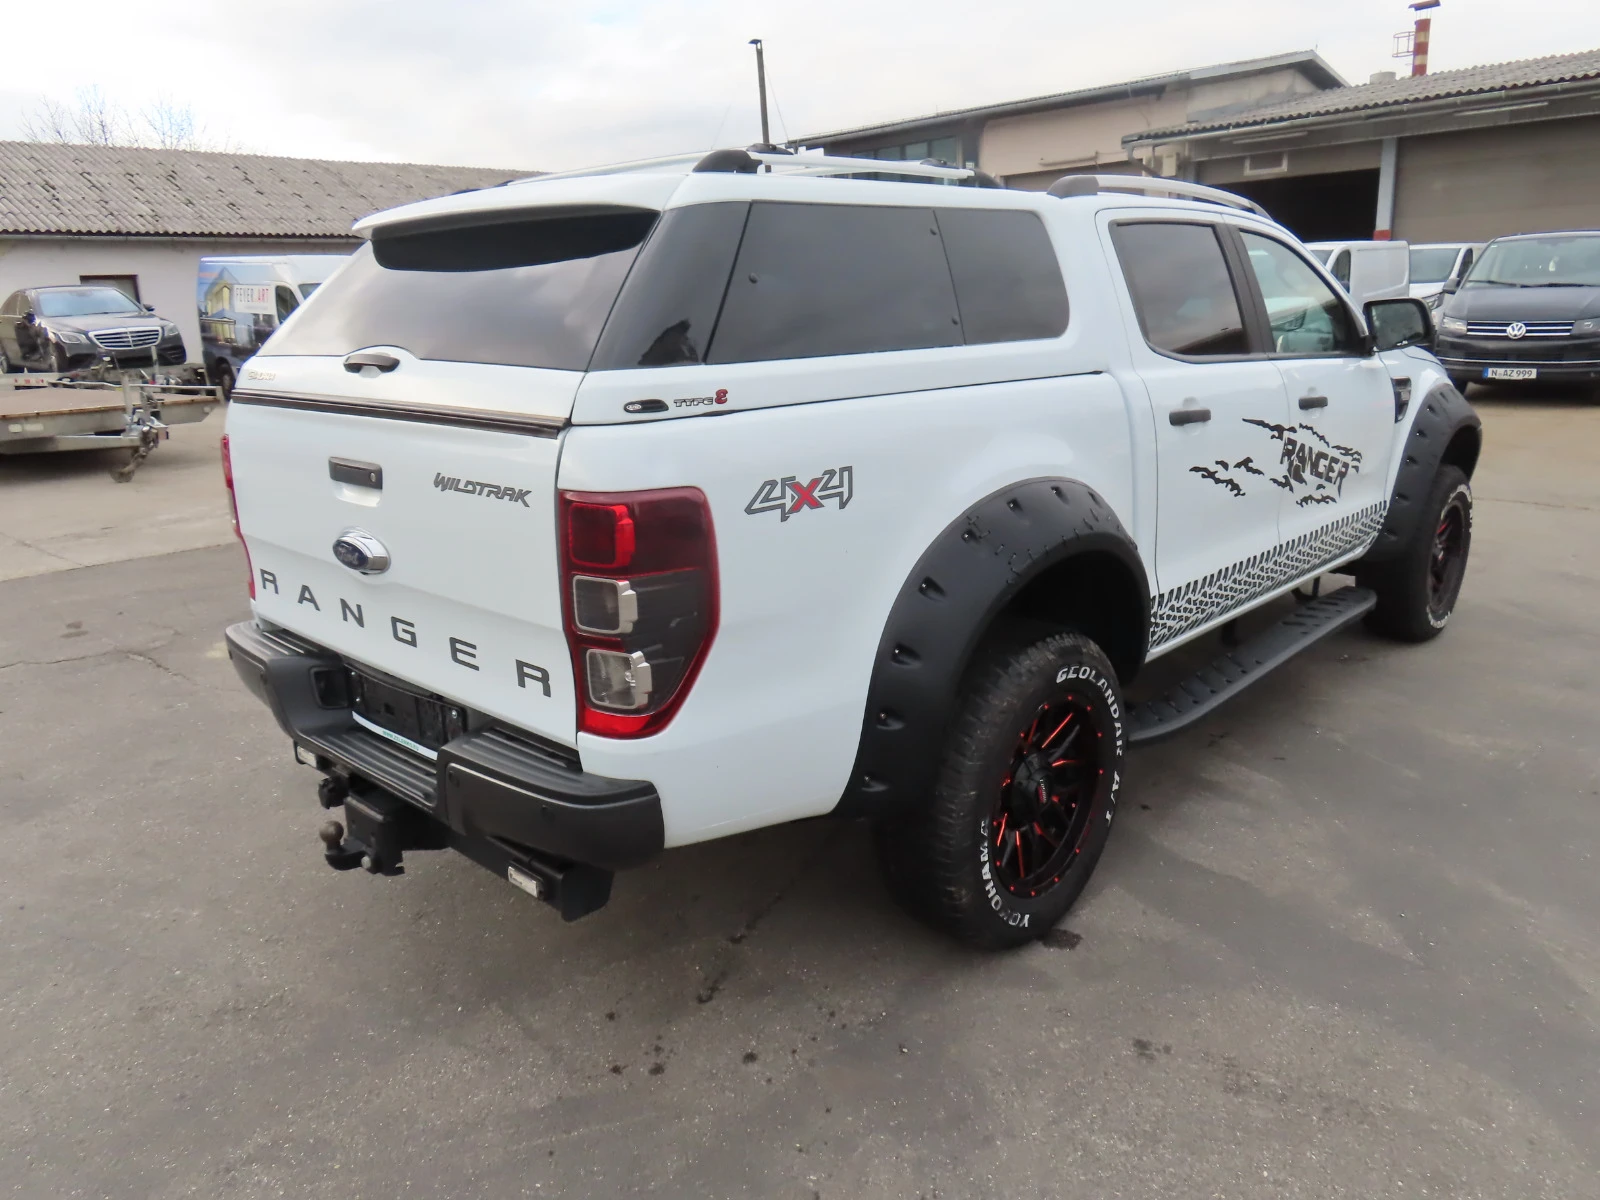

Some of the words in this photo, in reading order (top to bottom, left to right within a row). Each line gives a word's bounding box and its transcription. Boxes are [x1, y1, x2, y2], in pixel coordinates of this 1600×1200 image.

[674, 397, 713, 407] TYPE
[433, 472, 532, 508] WILDTRAK
[1280, 436, 1351, 498] RANGER
[259, 568, 552, 698] RANGER
[1056, 665, 1123, 756] GEOLANDAR
